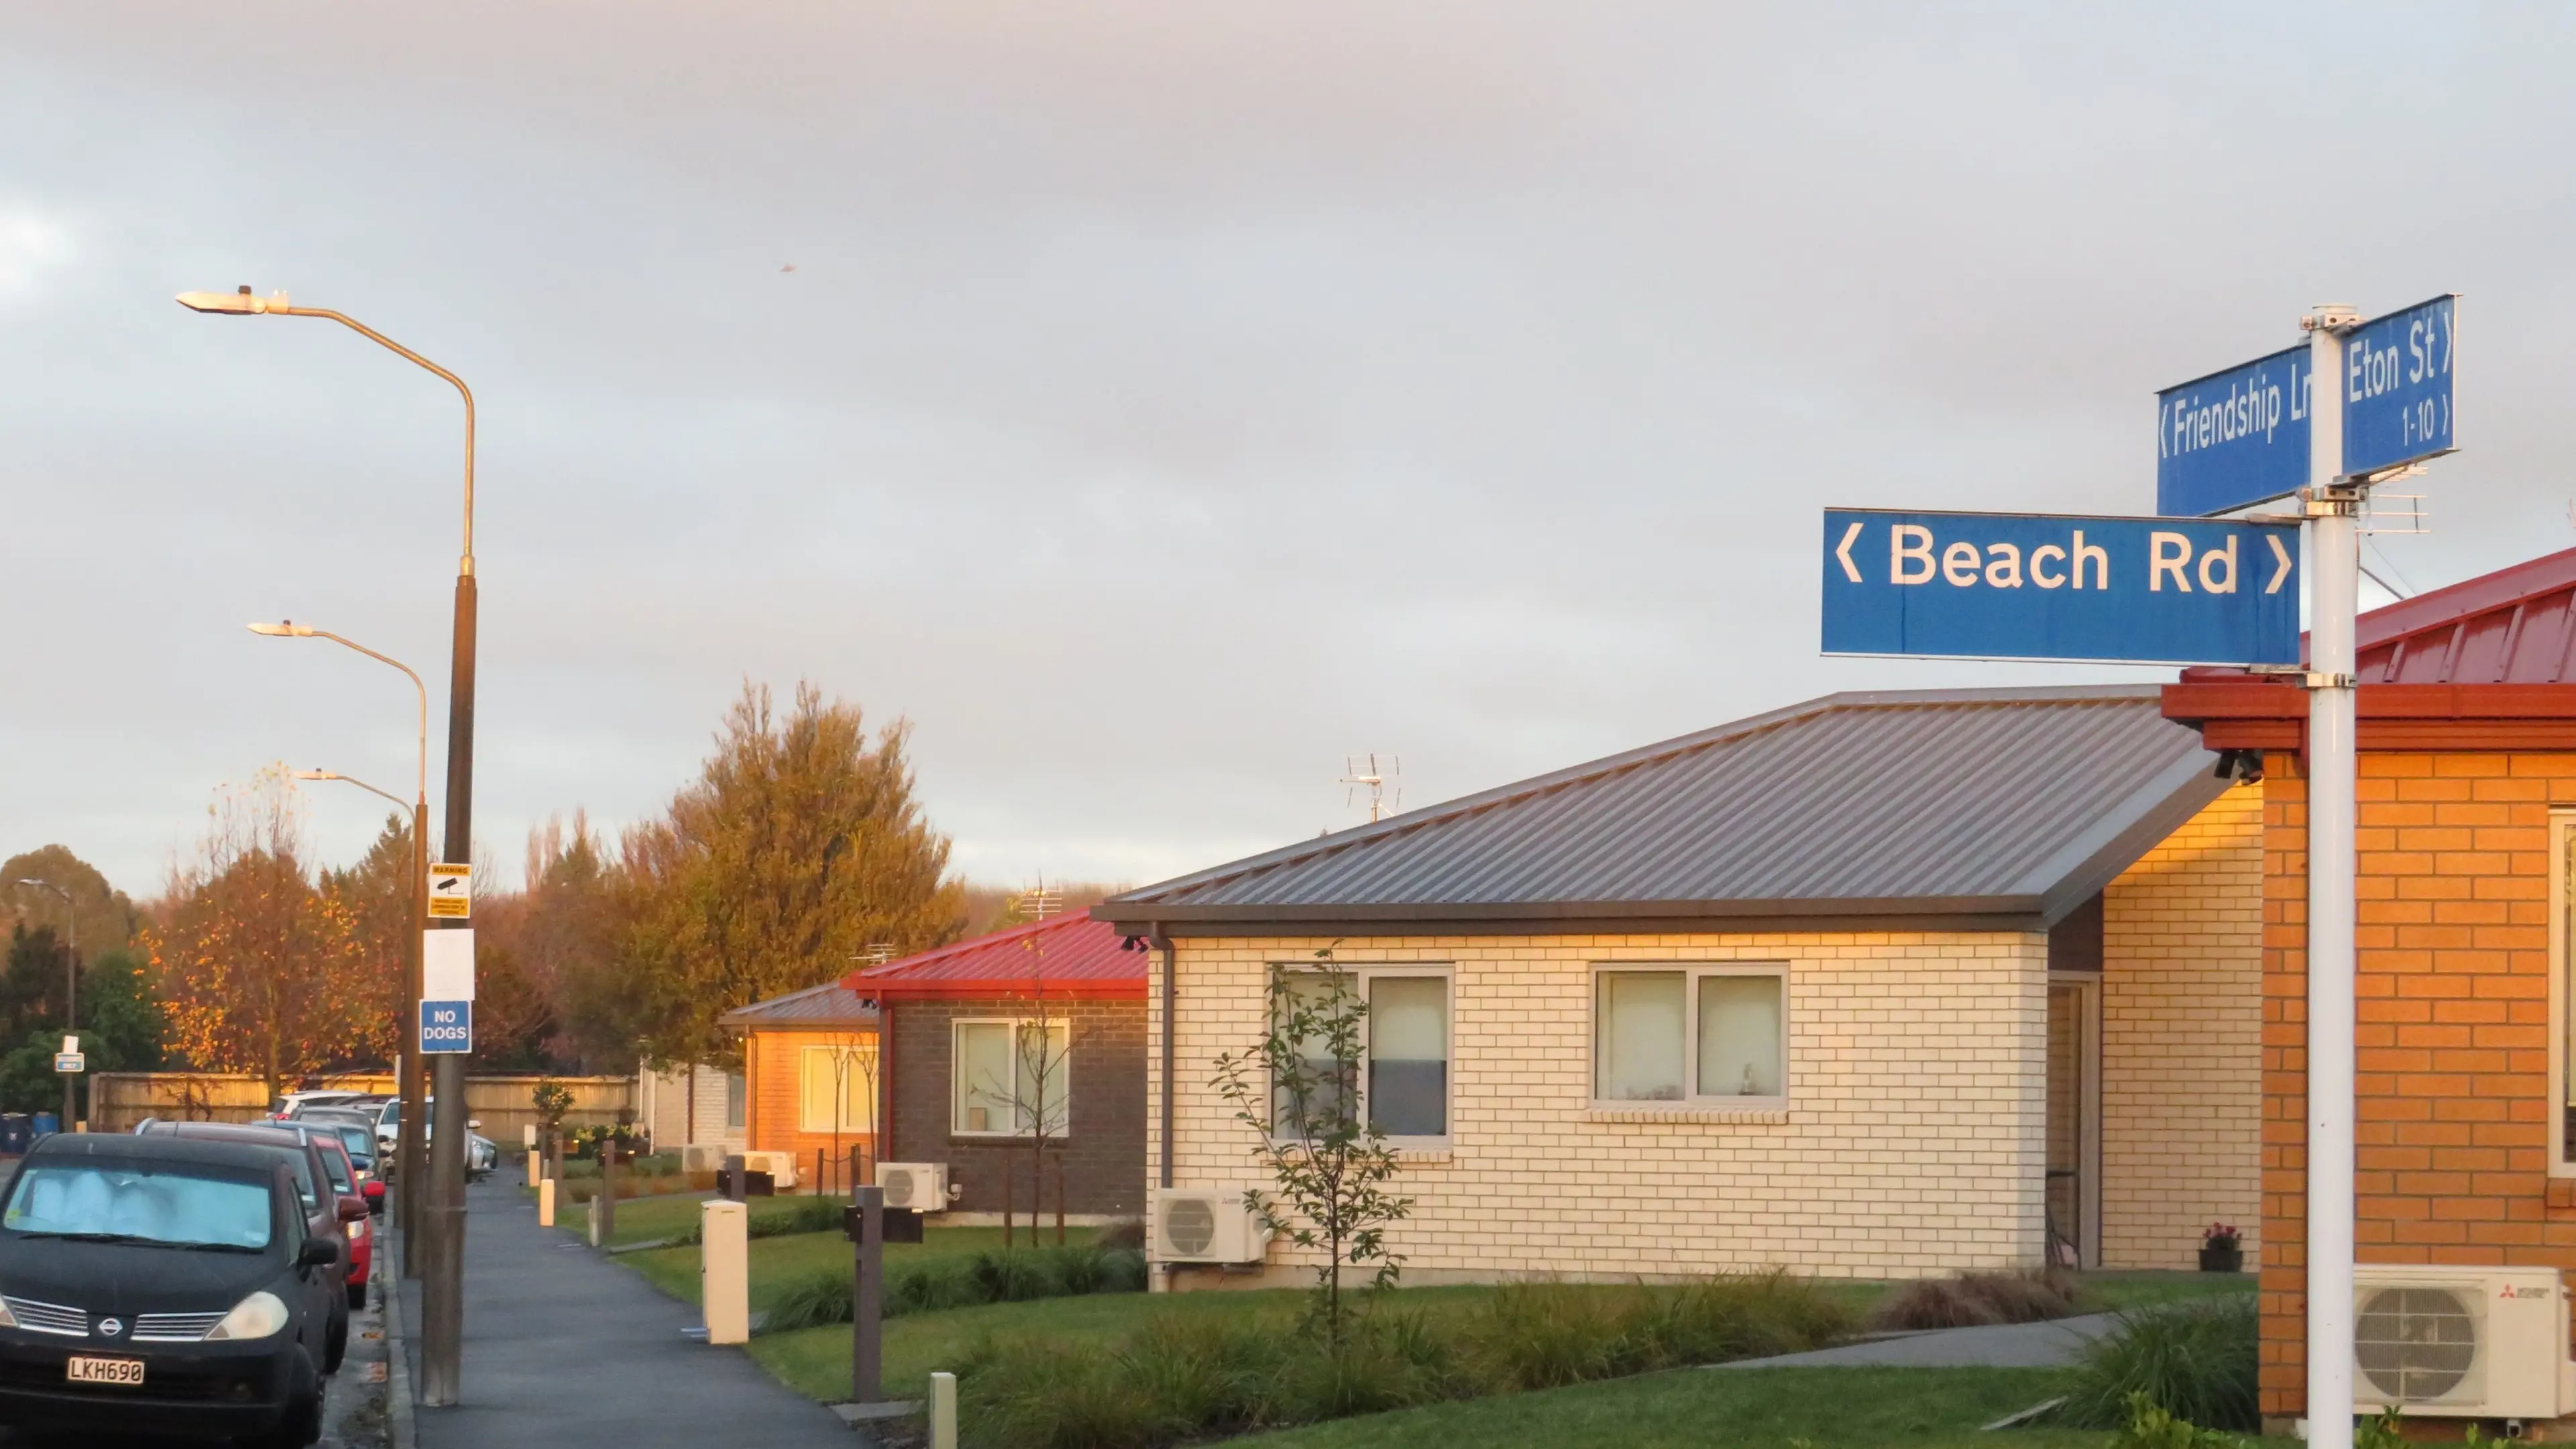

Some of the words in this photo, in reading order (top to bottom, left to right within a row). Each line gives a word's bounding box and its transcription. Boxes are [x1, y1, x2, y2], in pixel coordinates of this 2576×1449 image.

[2350, 339, 2399, 402] Eton
[2410, 317, 2435, 384] St
[2174, 374, 2280, 456] Friendship
[2292, 364, 2313, 421] Ln
[2403, 398, 2434, 446] 1-10
[1891, 525, 2108, 590] Beach
[2150, 532, 2237, 594] Rd
[424, 1026, 467, 1040] DOGS
[434, 1010, 456, 1023] NO
[71, 1360, 142, 1381] LKH690
